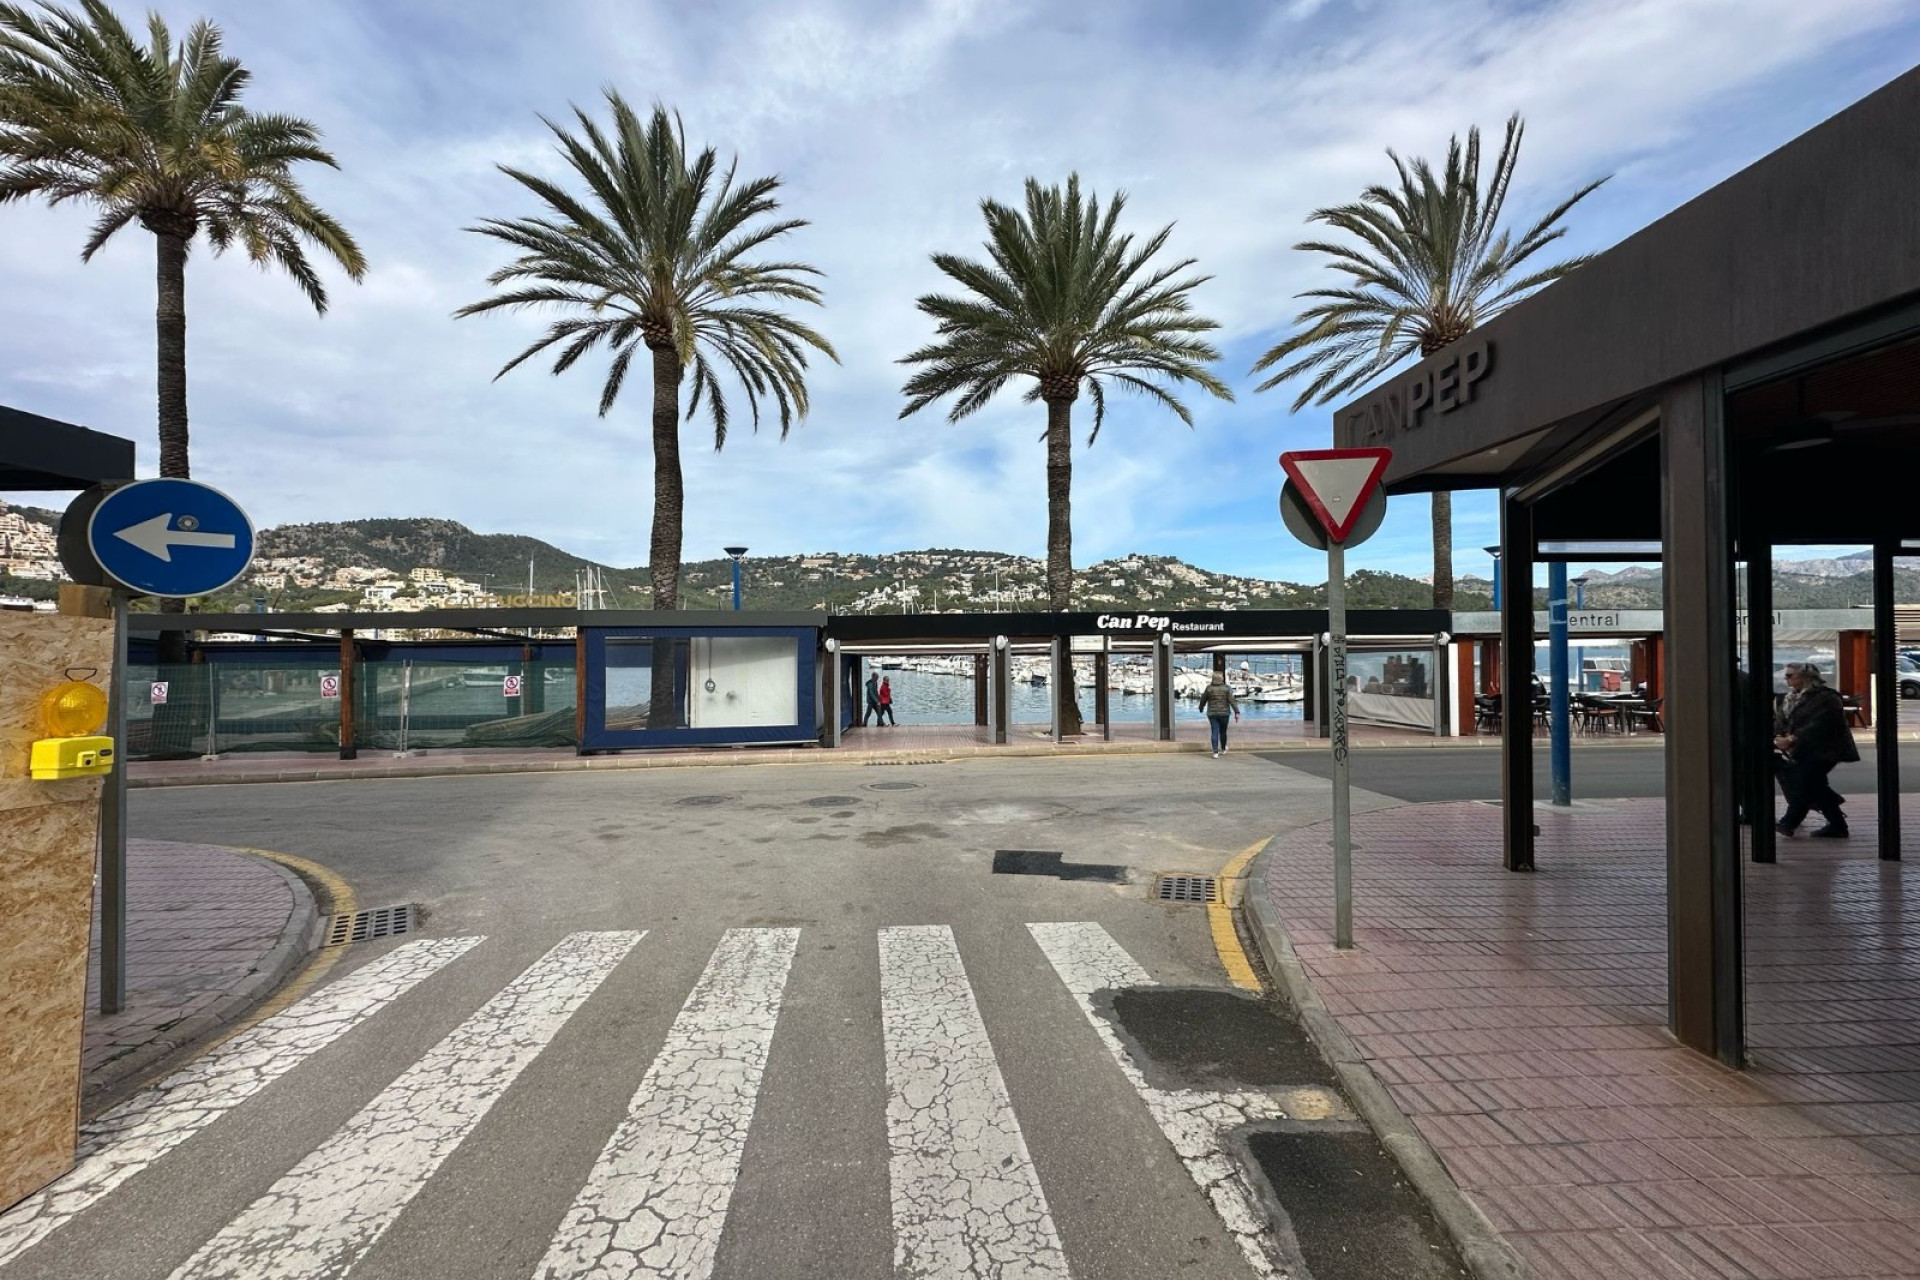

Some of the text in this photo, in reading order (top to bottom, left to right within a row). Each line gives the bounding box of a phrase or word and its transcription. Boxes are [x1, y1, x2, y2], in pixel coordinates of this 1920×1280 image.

[443, 593, 577, 608] CAPPUCCINO
[1097, 614, 1225, 631] Can Pep Restaurant
[1569, 613, 1619, 626] entral
